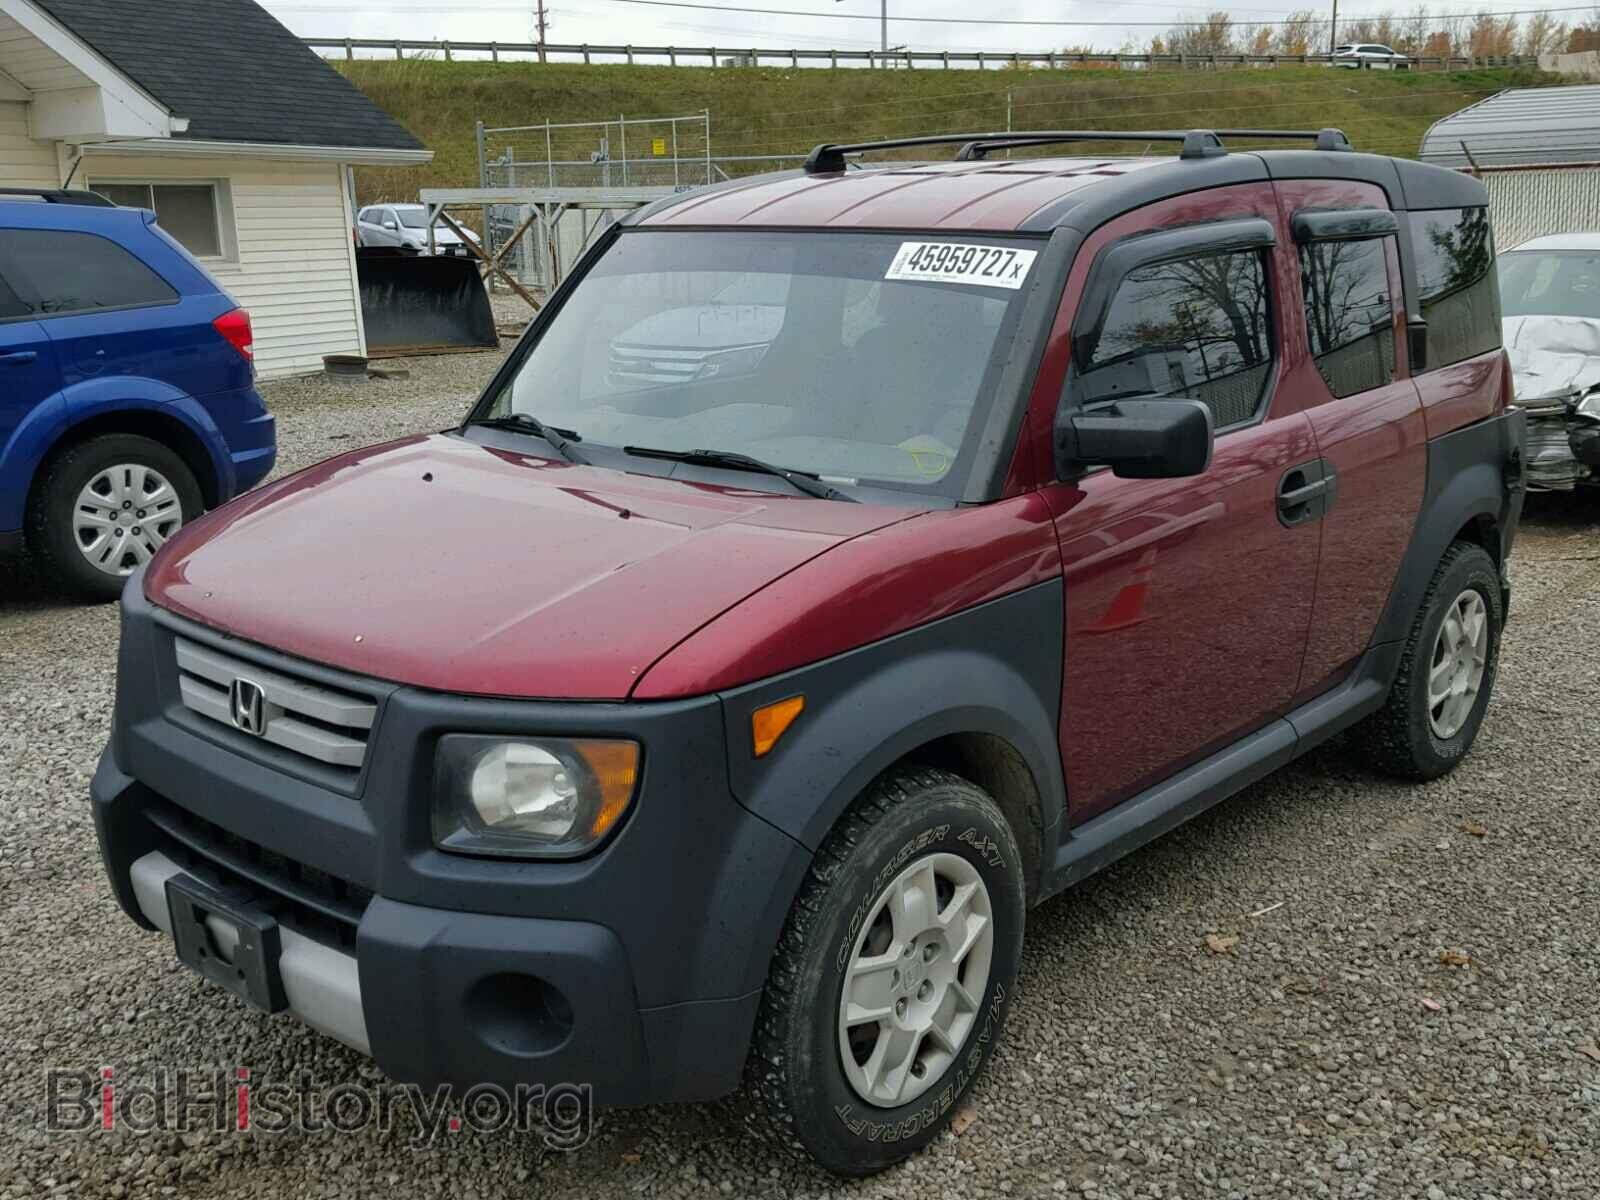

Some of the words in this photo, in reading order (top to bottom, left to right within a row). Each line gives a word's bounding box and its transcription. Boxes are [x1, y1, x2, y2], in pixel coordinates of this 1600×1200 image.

[836, 824, 950, 974] COURSER
[957, 827, 1007, 868] AXT
[835, 983, 1006, 1142] MASTERCRAFT
